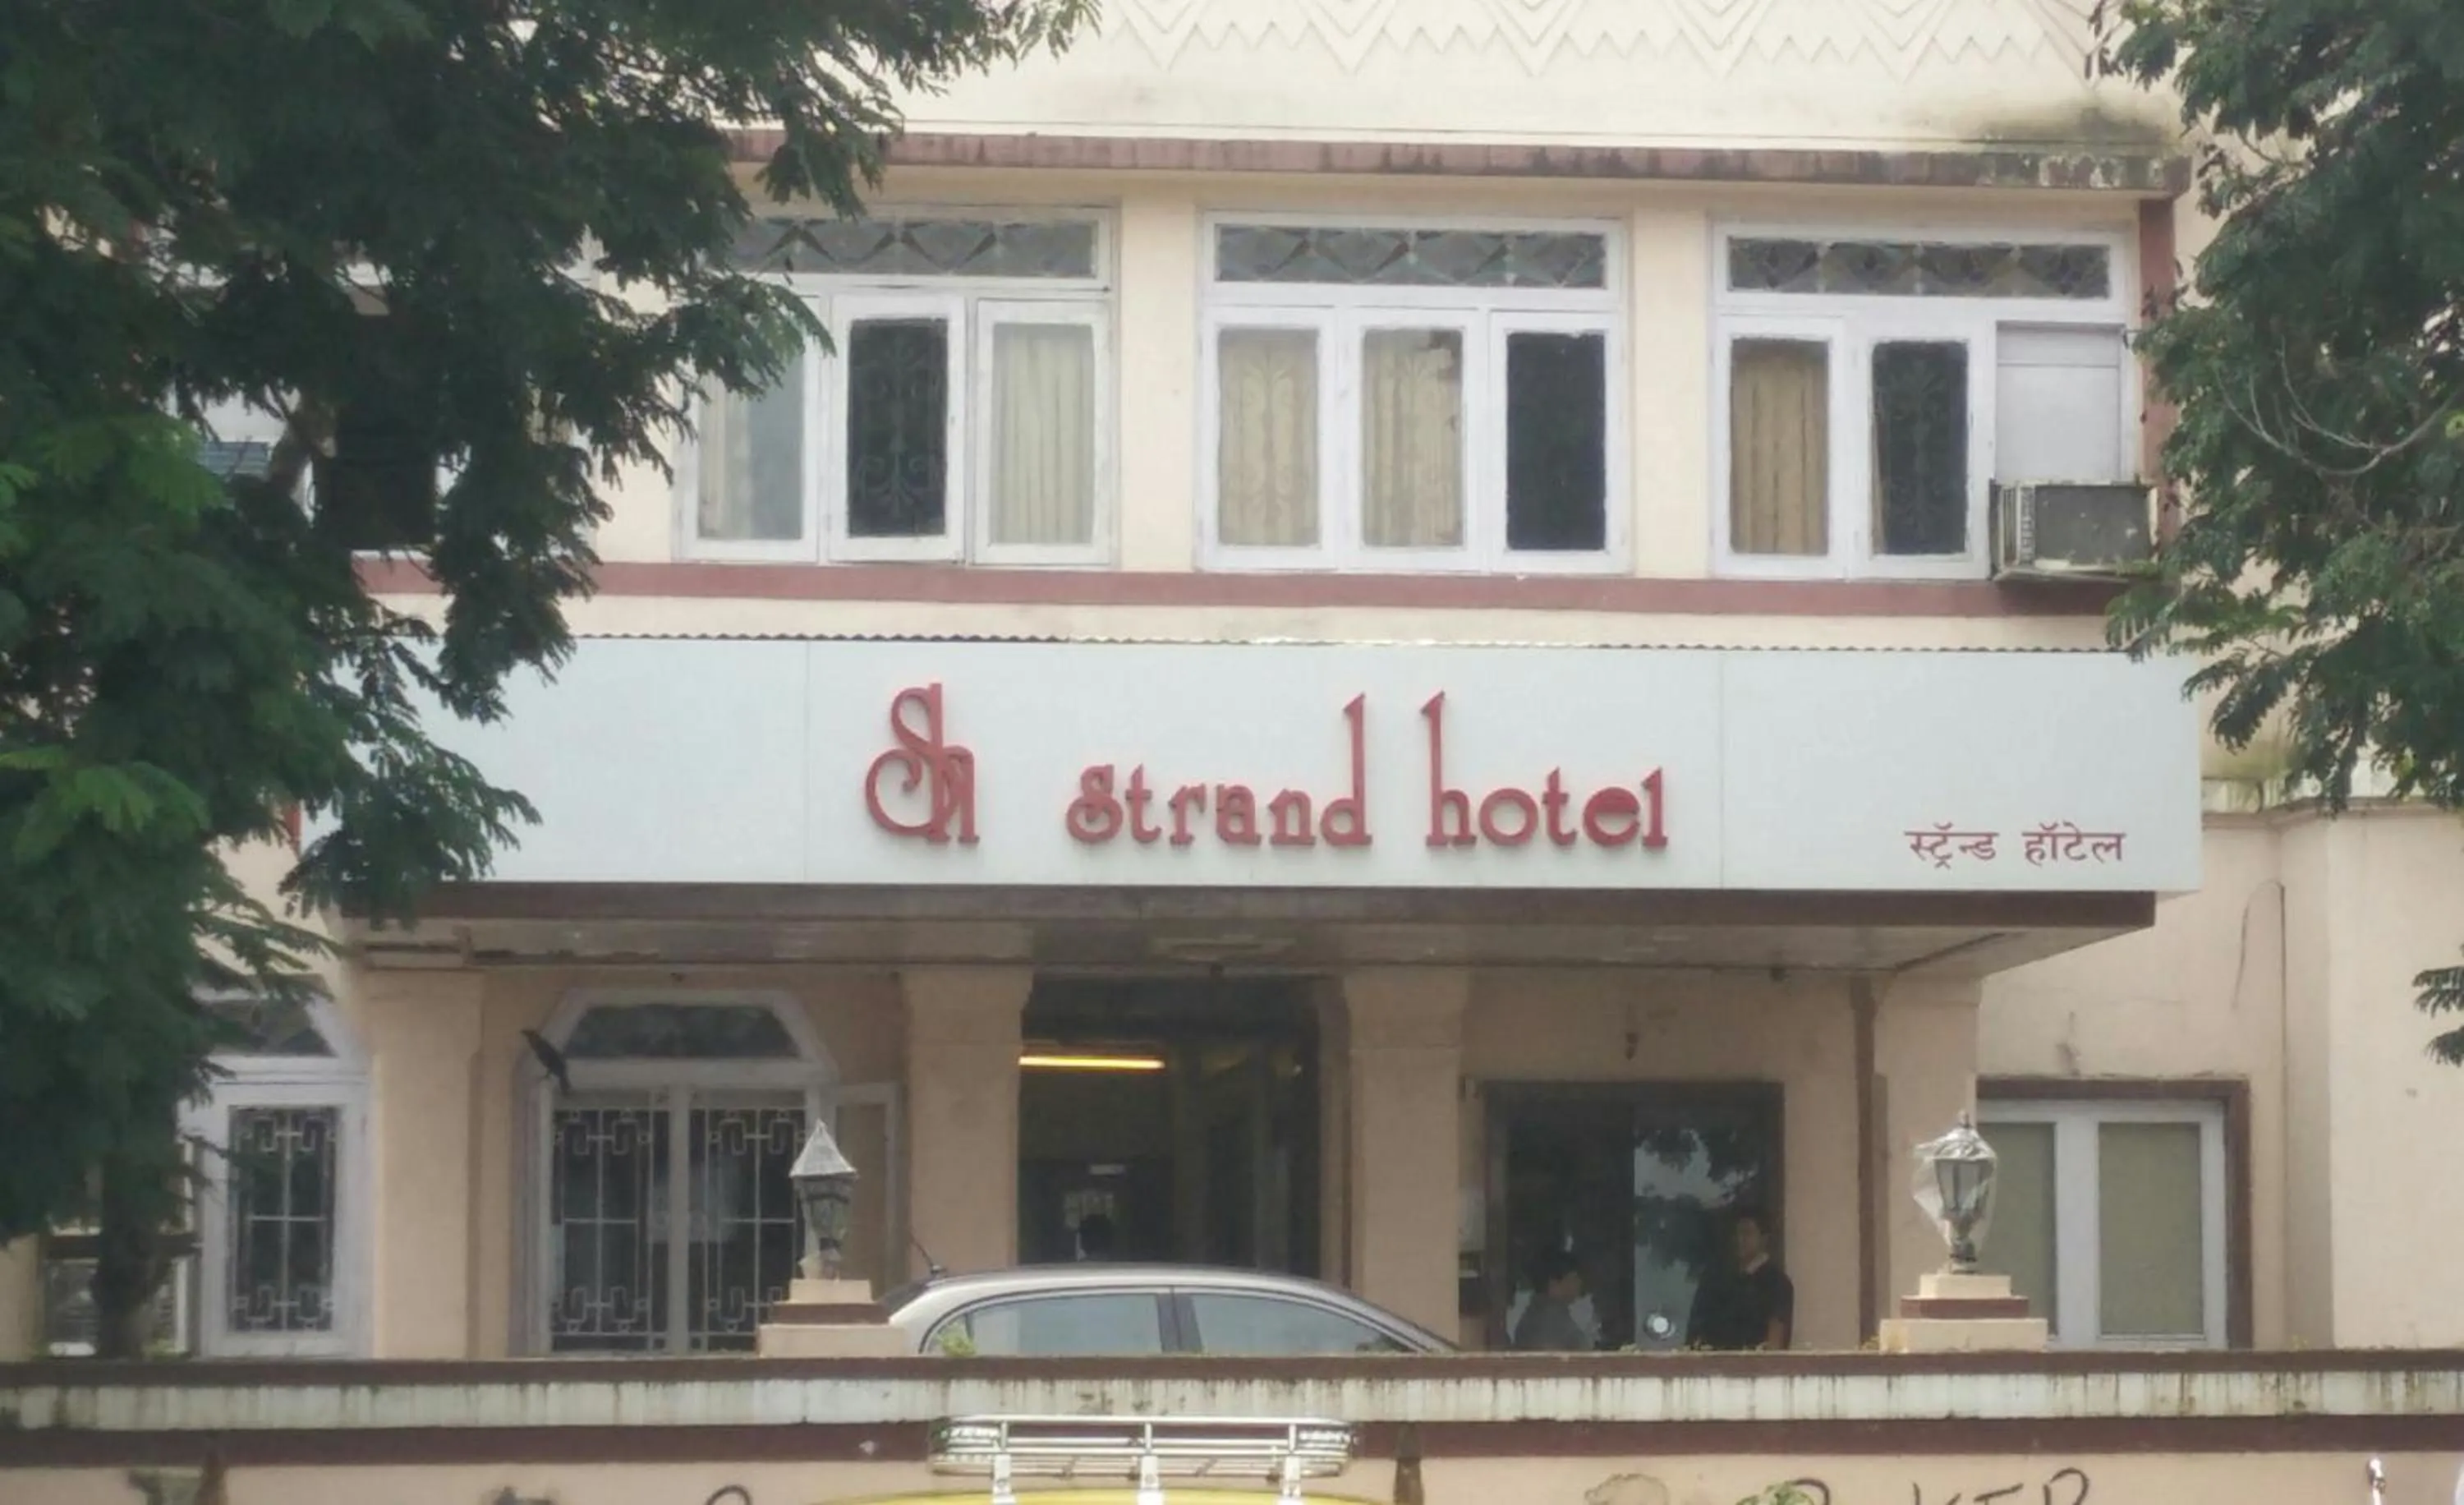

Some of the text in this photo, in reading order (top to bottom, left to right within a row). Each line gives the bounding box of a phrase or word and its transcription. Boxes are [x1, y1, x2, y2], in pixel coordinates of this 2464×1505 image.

[1065, 690, 1669, 849] strand hotel
[2021, 820, 2126, 866] हॉटेल
